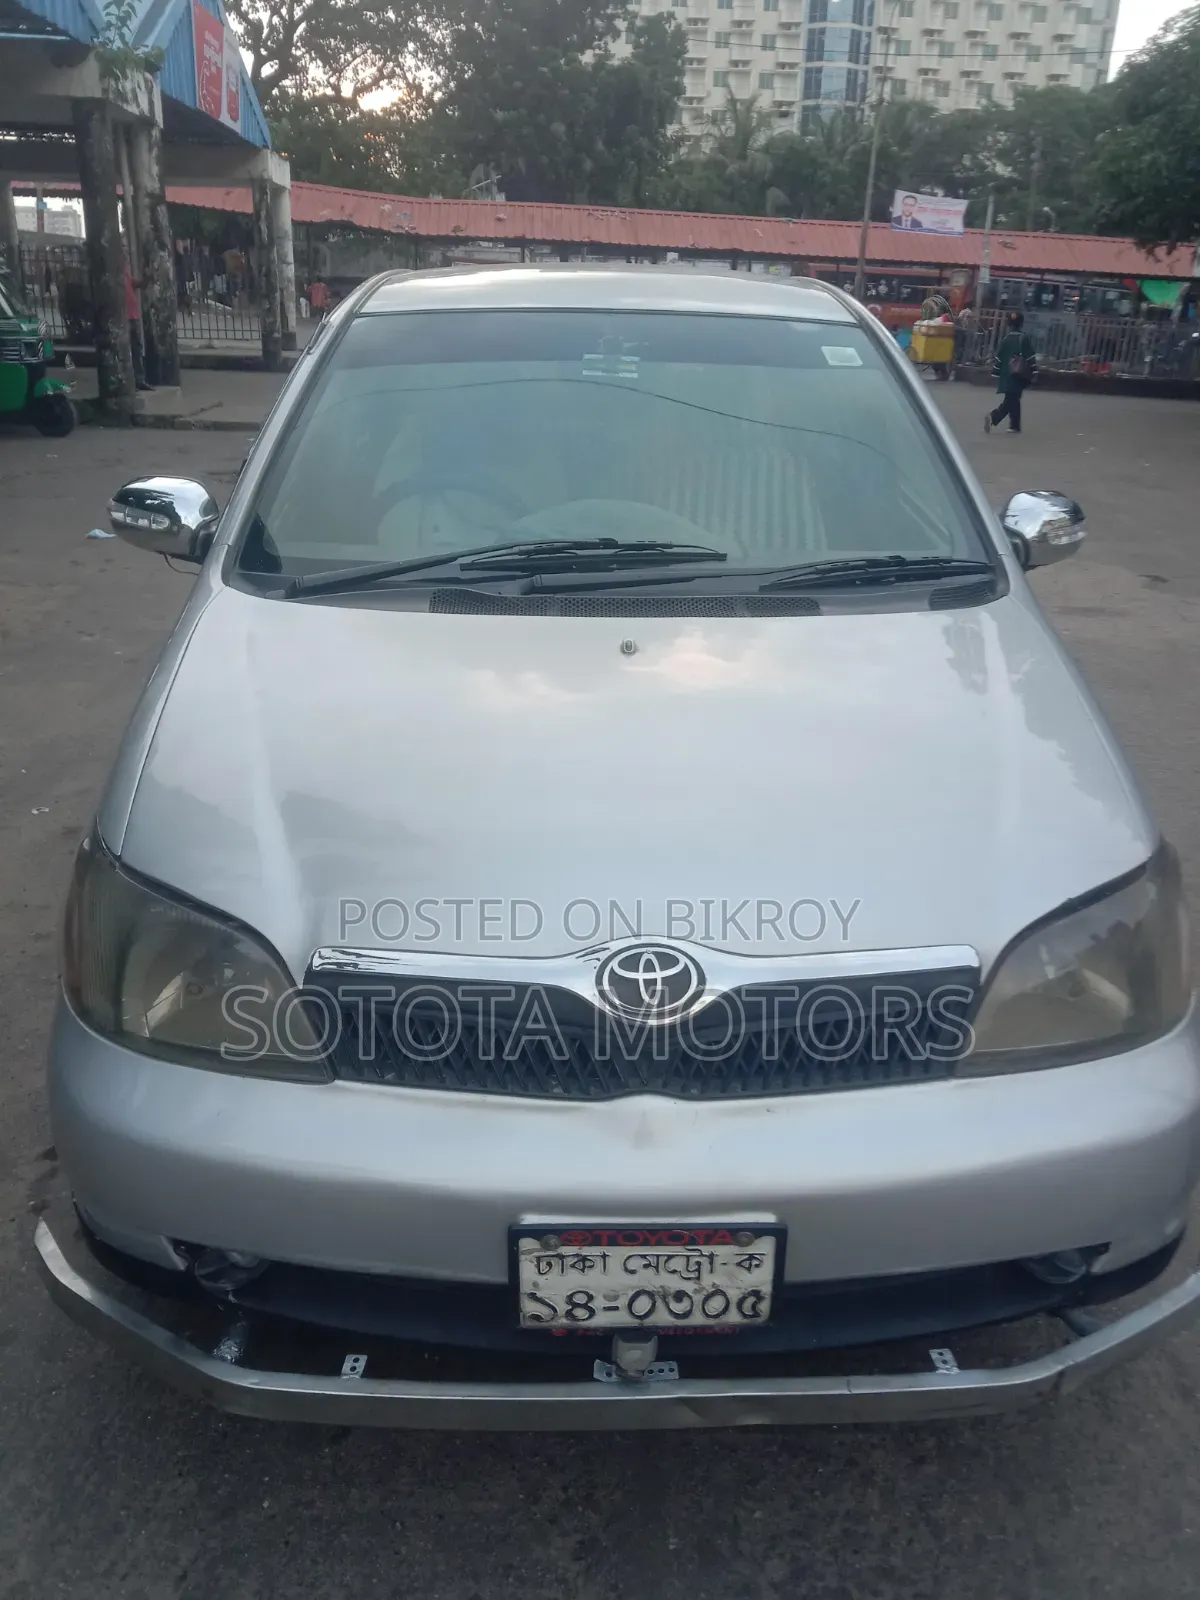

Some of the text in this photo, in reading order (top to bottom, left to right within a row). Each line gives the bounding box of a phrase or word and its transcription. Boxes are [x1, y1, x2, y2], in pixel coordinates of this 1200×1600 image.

[593, 1230, 735, 1246] TOYOTA
[534, 1251, 611, 1275] ঢাকা
[526, 1289, 766, 1322] ১৪-০৩০৫
